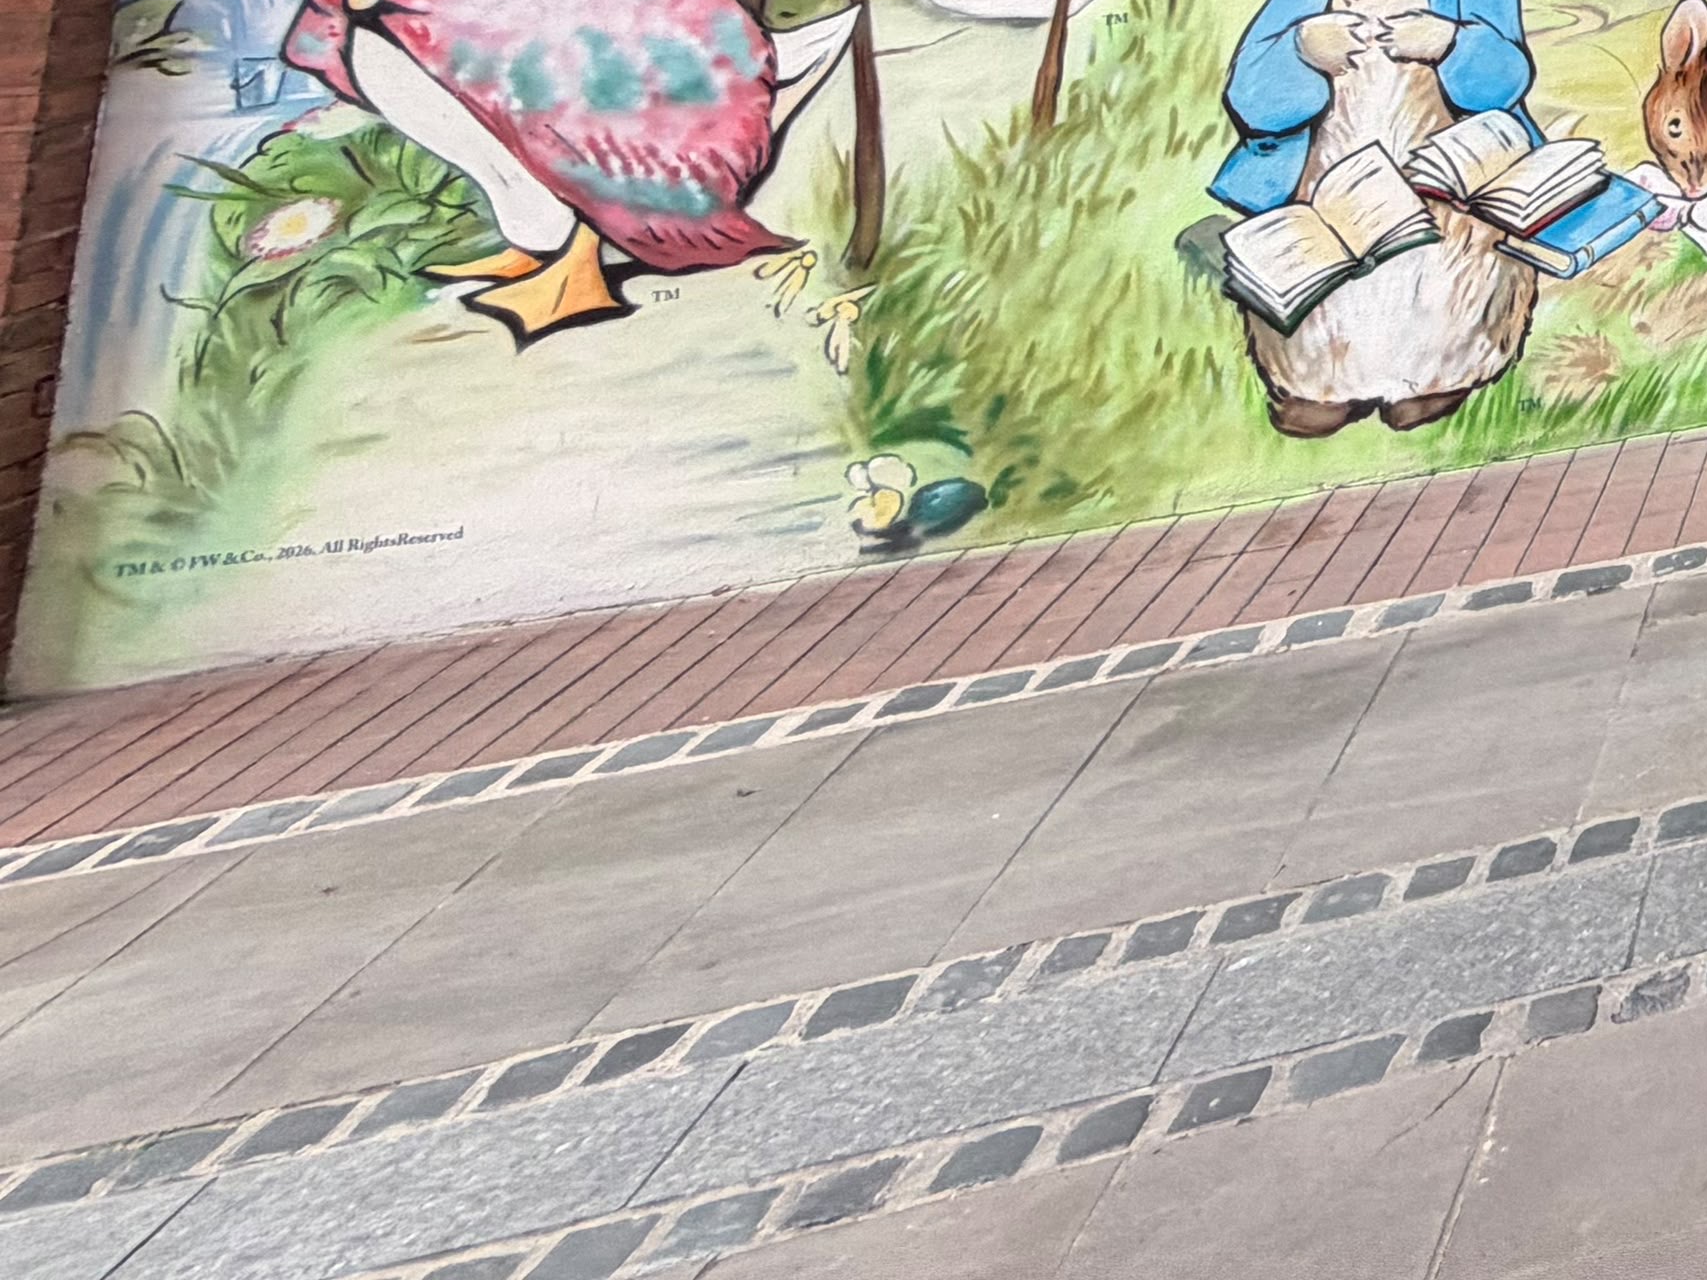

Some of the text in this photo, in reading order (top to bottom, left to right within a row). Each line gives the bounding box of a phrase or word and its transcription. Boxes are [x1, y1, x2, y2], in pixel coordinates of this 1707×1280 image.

[651, 287, 680, 303] TM
[114, 563, 147, 578] TM
[149, 560, 165, 575] &
[189, 554, 222, 572] FW
[321, 539, 344, 555] All
